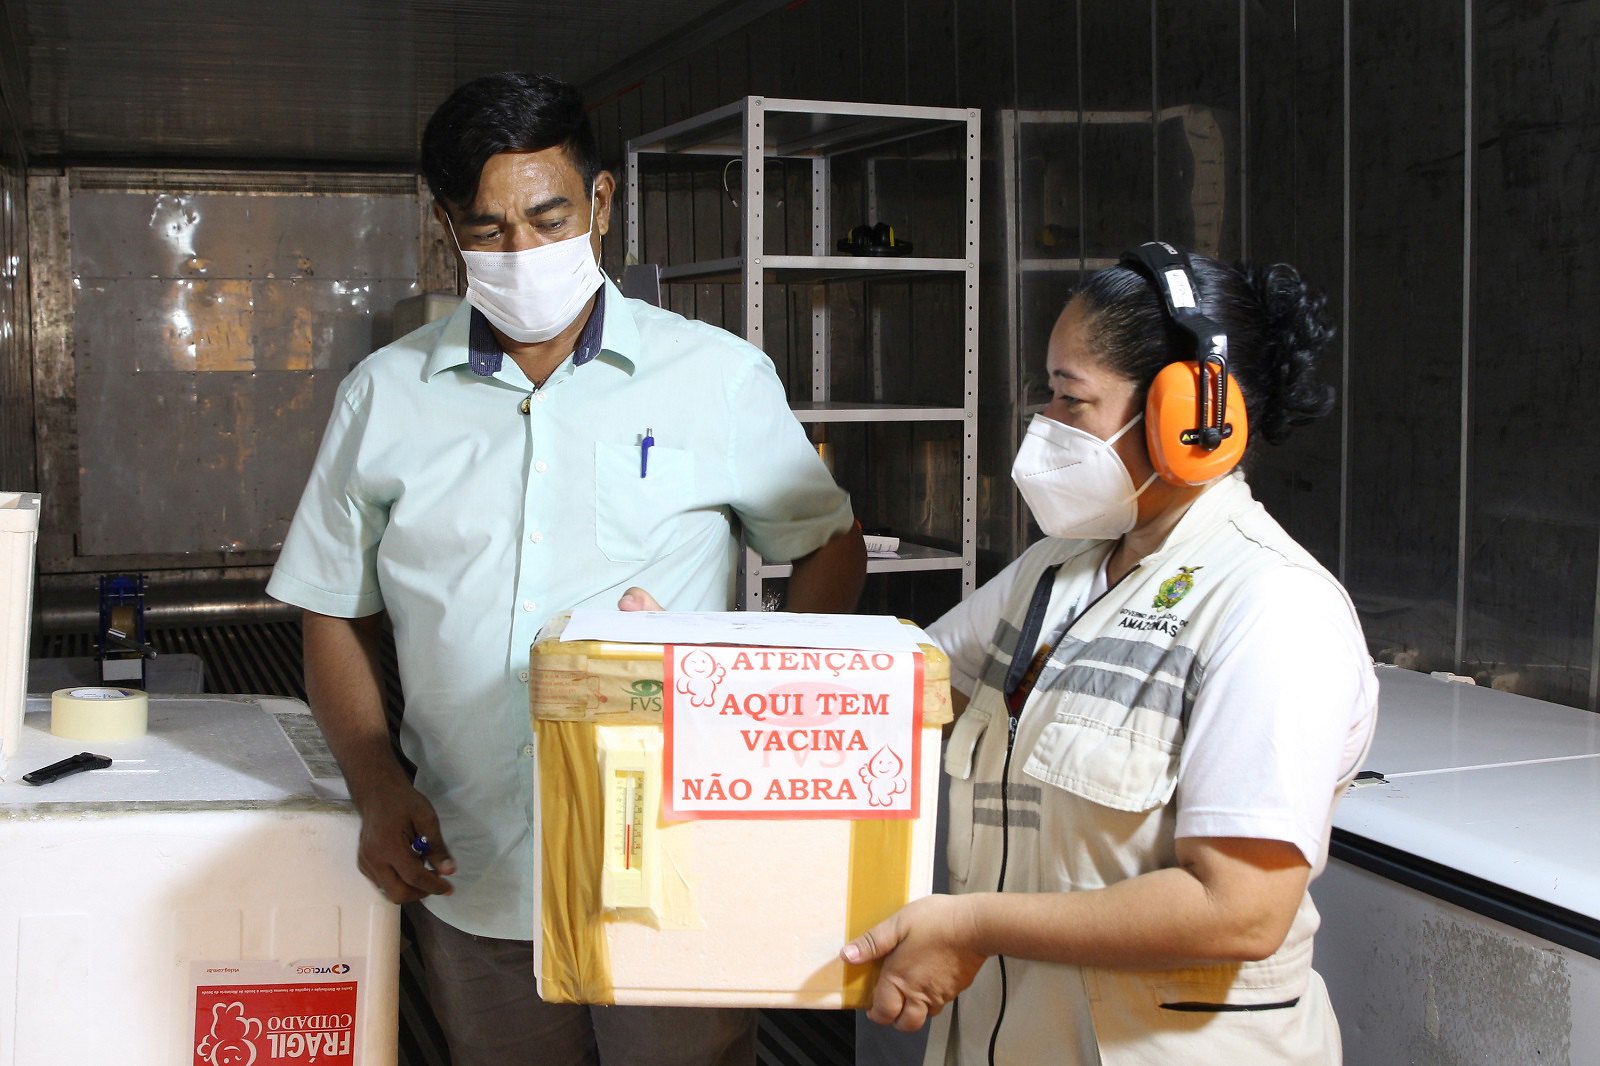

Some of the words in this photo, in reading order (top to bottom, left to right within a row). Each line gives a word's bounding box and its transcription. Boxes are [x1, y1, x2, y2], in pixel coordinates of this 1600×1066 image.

[1118, 617, 1178, 637] AMAZONAS
[630, 697, 662, 712] FVS
[719, 693, 804, 722] AQUI
[816, 693, 890, 716] TEM
[740, 729, 869, 752] VACINA
[682, 773, 753, 801] NÃO
[764, 778, 858, 801] ABRA
[296, 966, 331, 974] VTCLOG
[267, 1014, 353, 1031] CUIDADO
[266, 1031, 351, 1063] FRÁGIL
